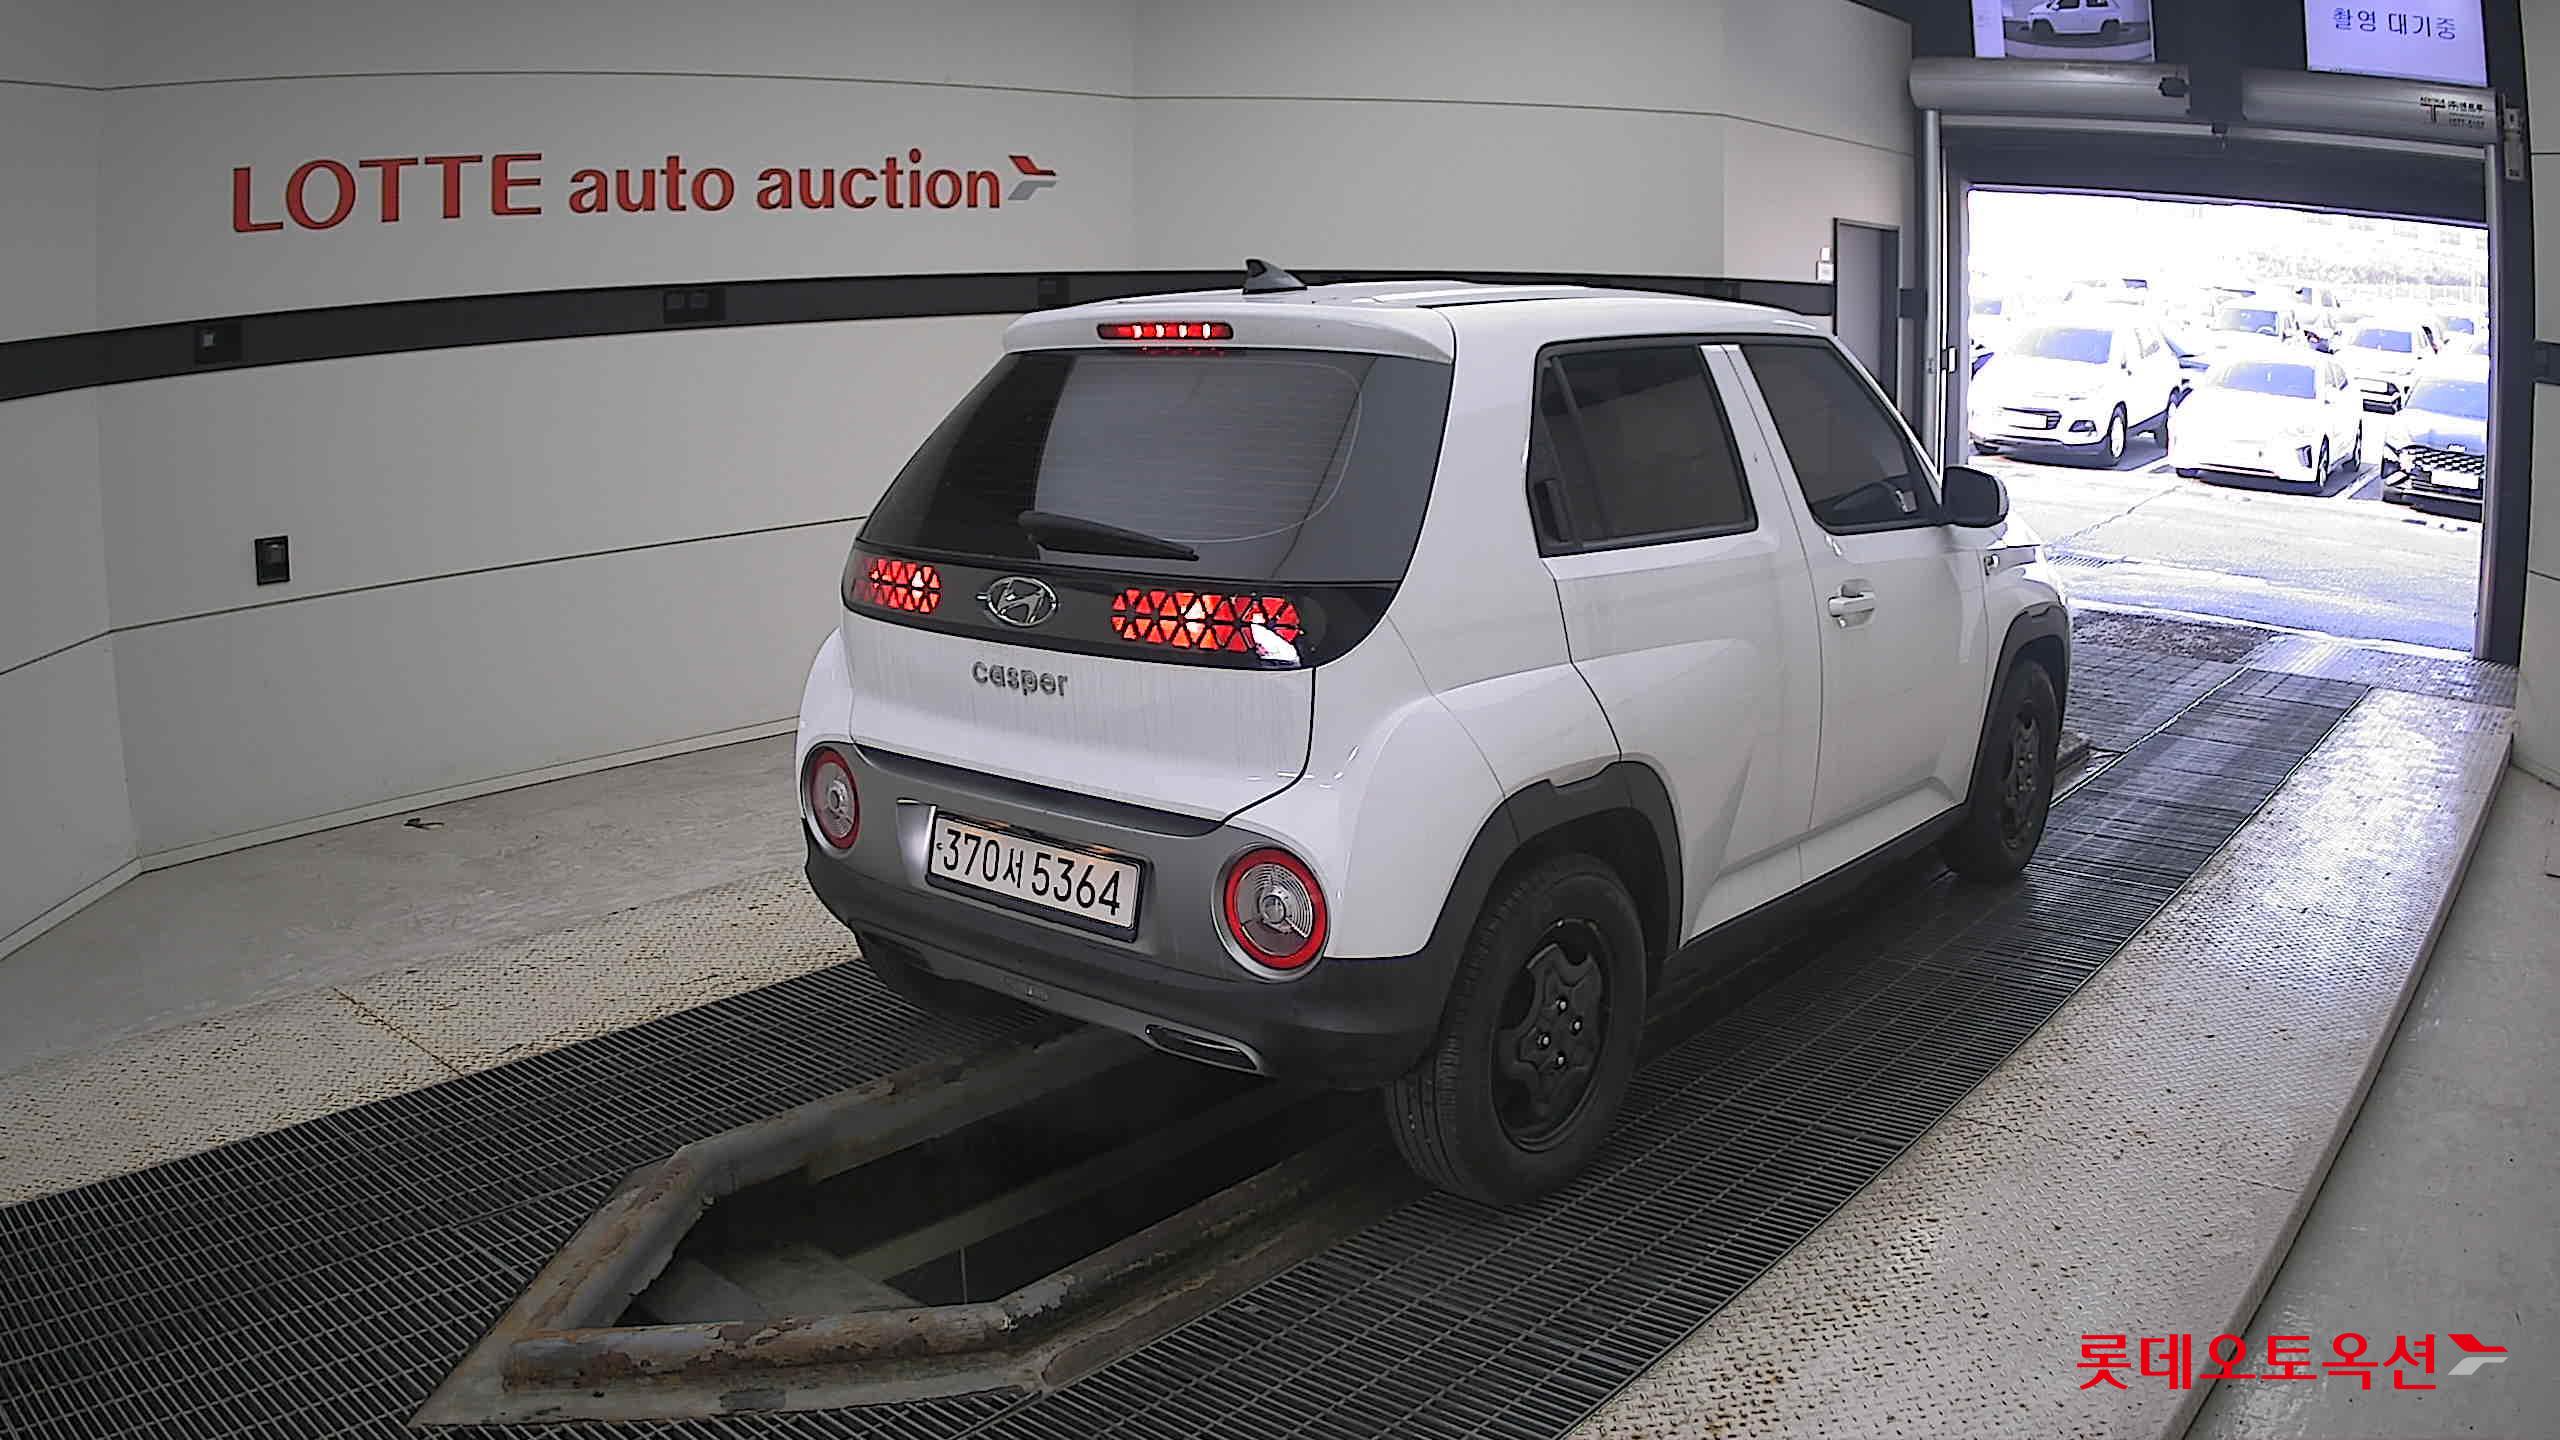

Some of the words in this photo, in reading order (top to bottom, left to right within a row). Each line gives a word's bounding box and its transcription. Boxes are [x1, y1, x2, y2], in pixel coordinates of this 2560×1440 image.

[2333, 8, 2376, 31] 촬영
[2388, 13, 2456, 40] 대기중
[233, 152, 543, 232] LOTTE
[568, 155, 735, 213] auto
[756, 147, 1001, 211] auction
